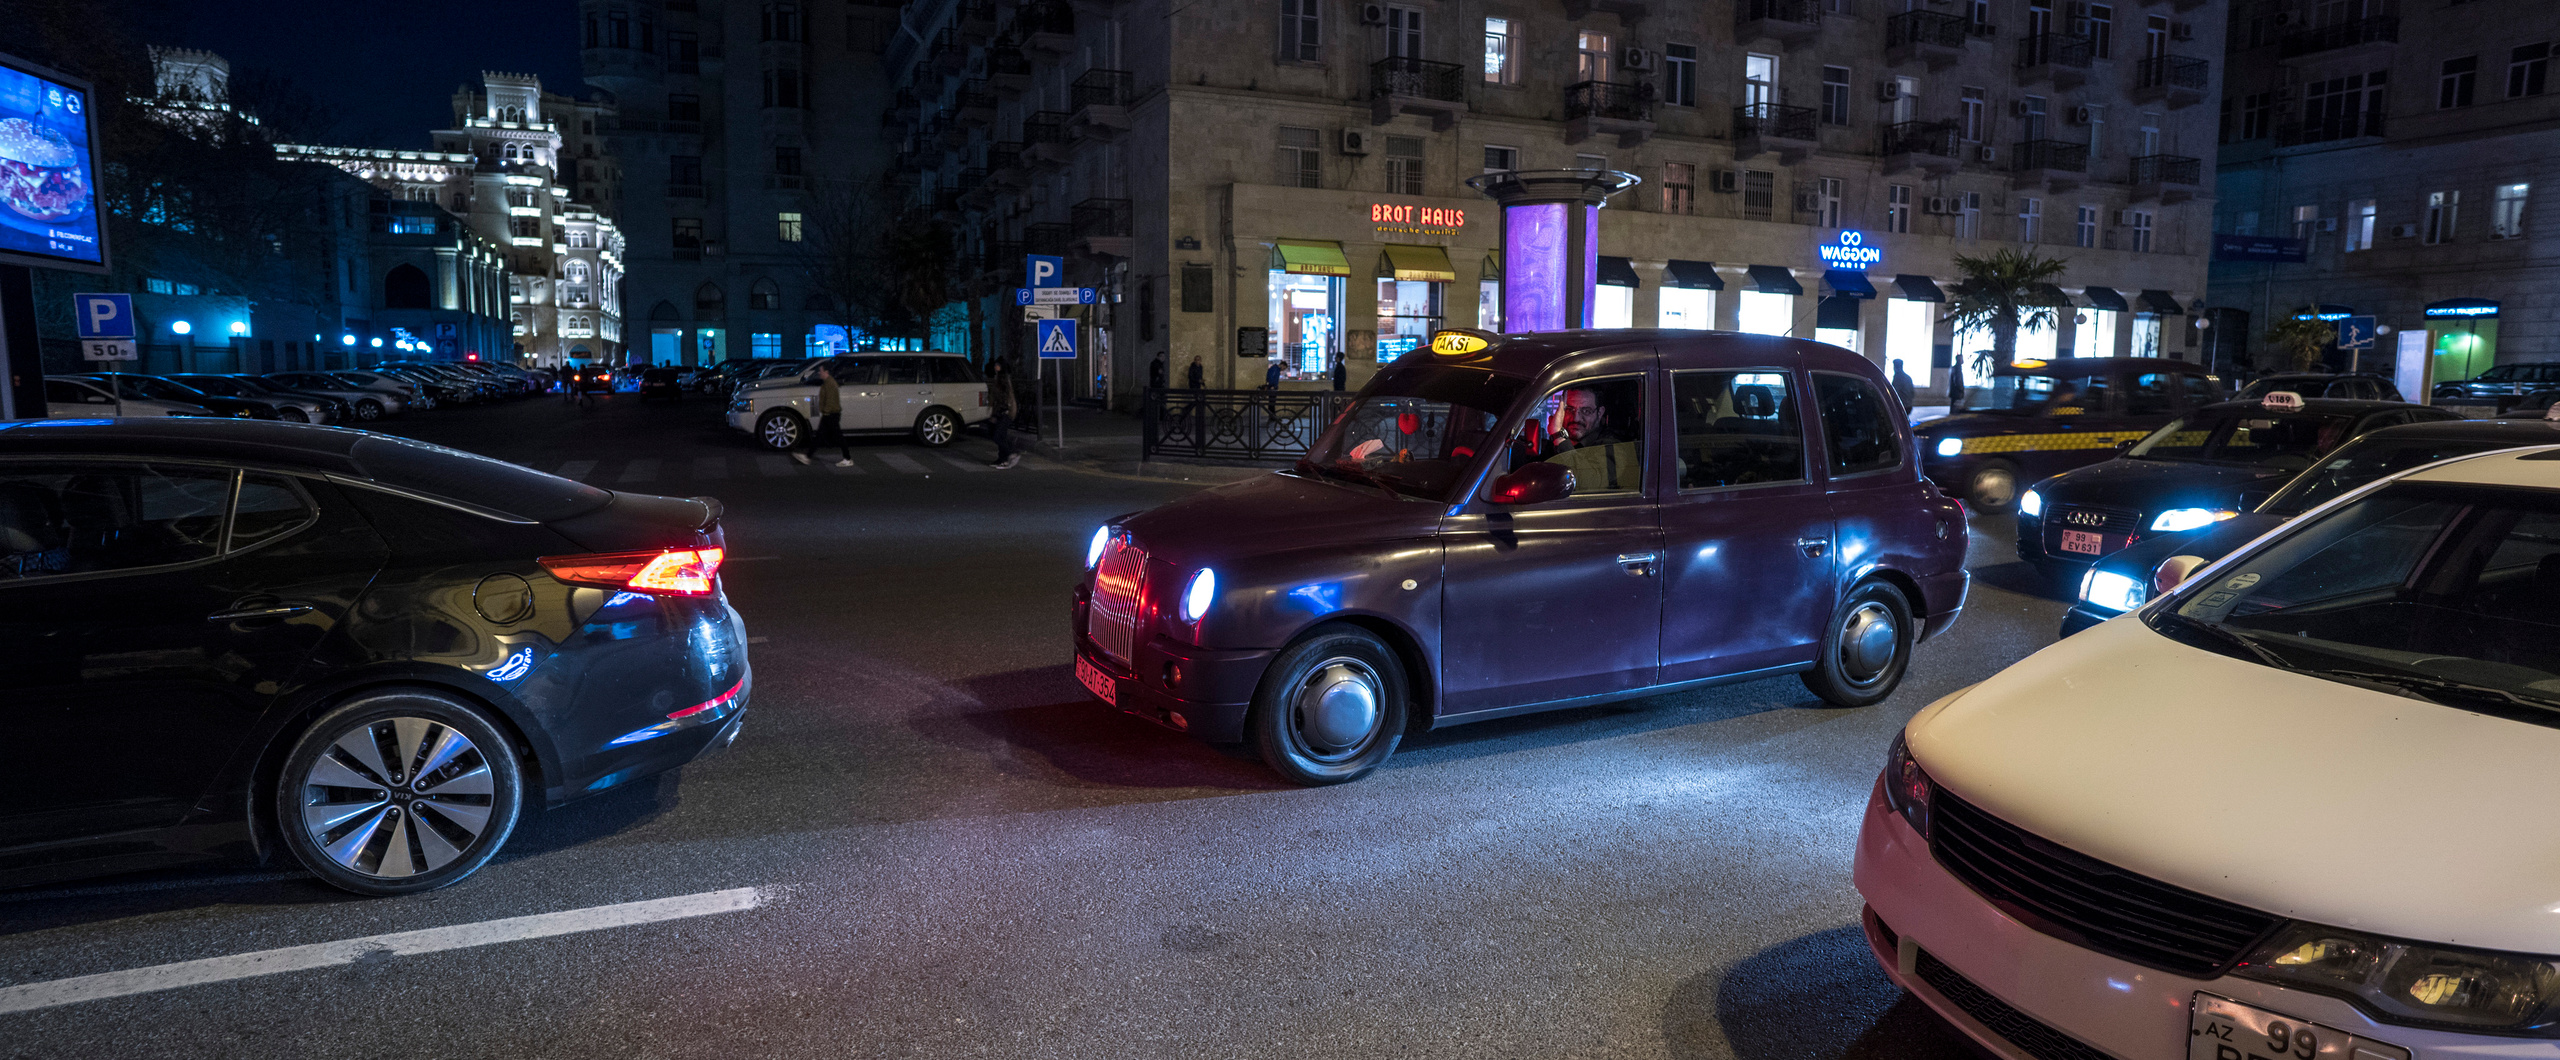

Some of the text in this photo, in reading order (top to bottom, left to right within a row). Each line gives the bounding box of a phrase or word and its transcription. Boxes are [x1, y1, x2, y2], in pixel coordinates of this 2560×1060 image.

[1372, 203, 1465, 227] BROT HAUS
[1820, 245, 1880, 263] WAGGON
[1034, 260, 1054, 286] P
[1832, 261, 1866, 270] PARIS
[89, 299, 117, 333] P
[2276, 395, 2290, 403] 189
[2076, 533, 2086, 542] 99
[394, 791, 412, 800] KIA
[2205, 1022, 2234, 1042] AZ
[2267, 1020, 2317, 1060] 99
